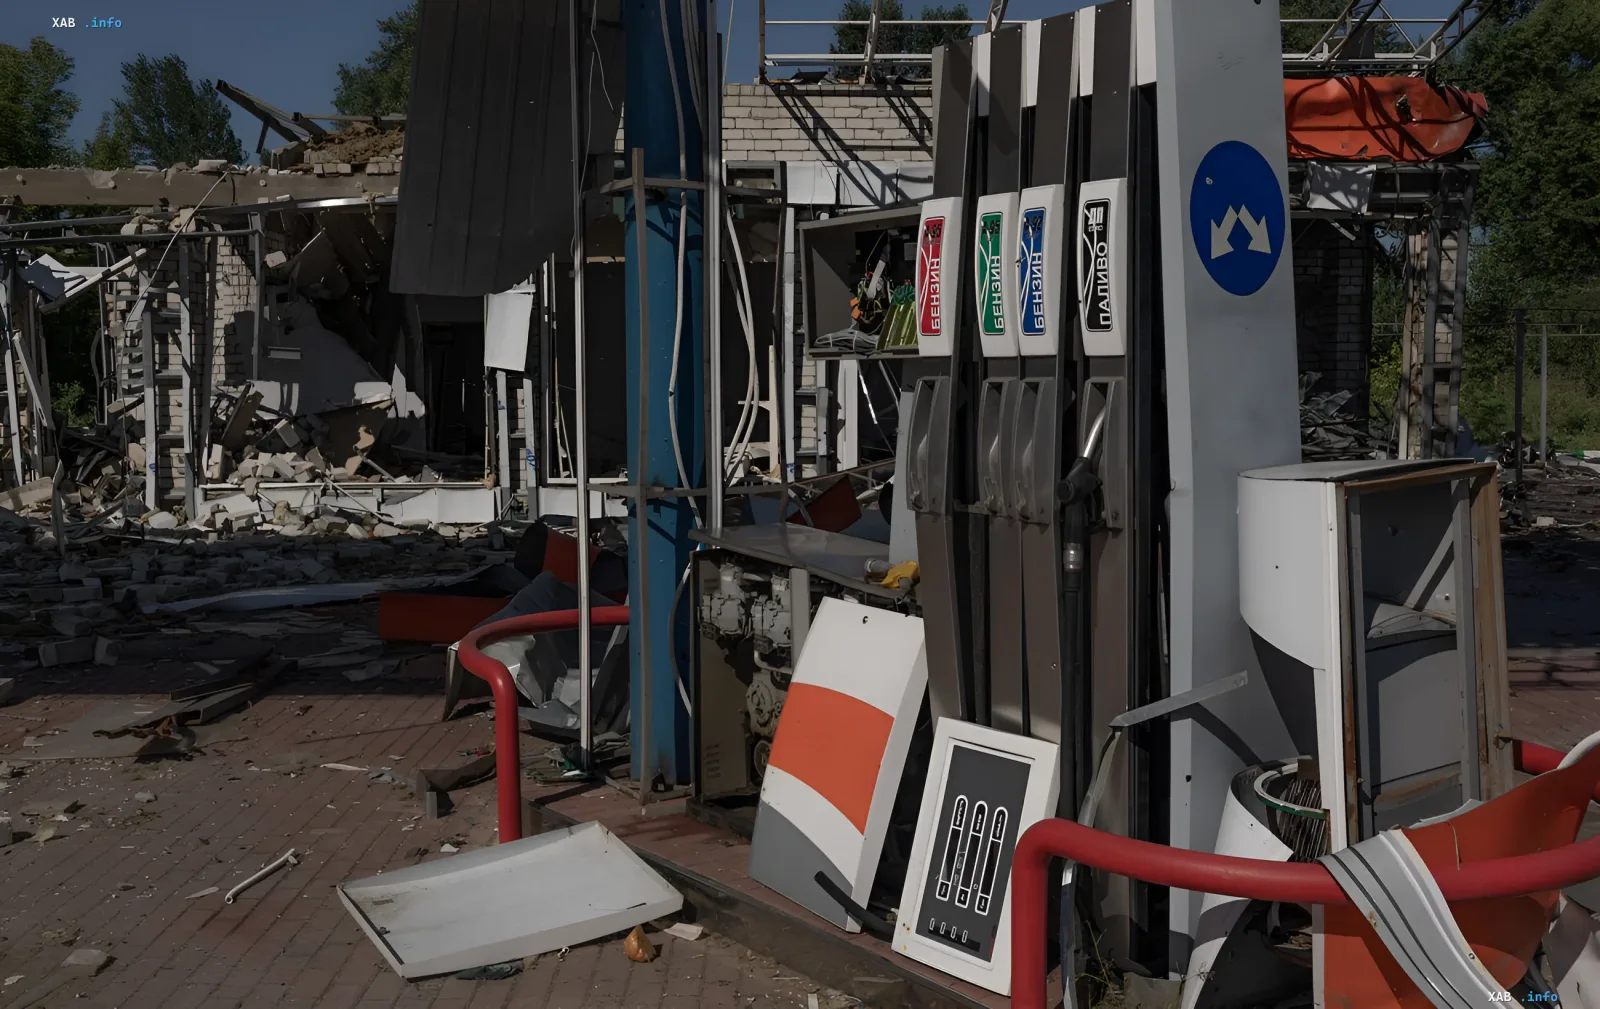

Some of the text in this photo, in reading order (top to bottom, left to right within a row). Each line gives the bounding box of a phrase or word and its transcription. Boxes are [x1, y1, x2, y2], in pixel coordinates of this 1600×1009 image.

[930, 257, 941, 330] БЕНЗИН
[991, 255, 1004, 329] БЕНЗИН
[1032, 252, 1045, 329] БЕНЗИН
[1096, 241, 1111, 325] ПАЛИВО
